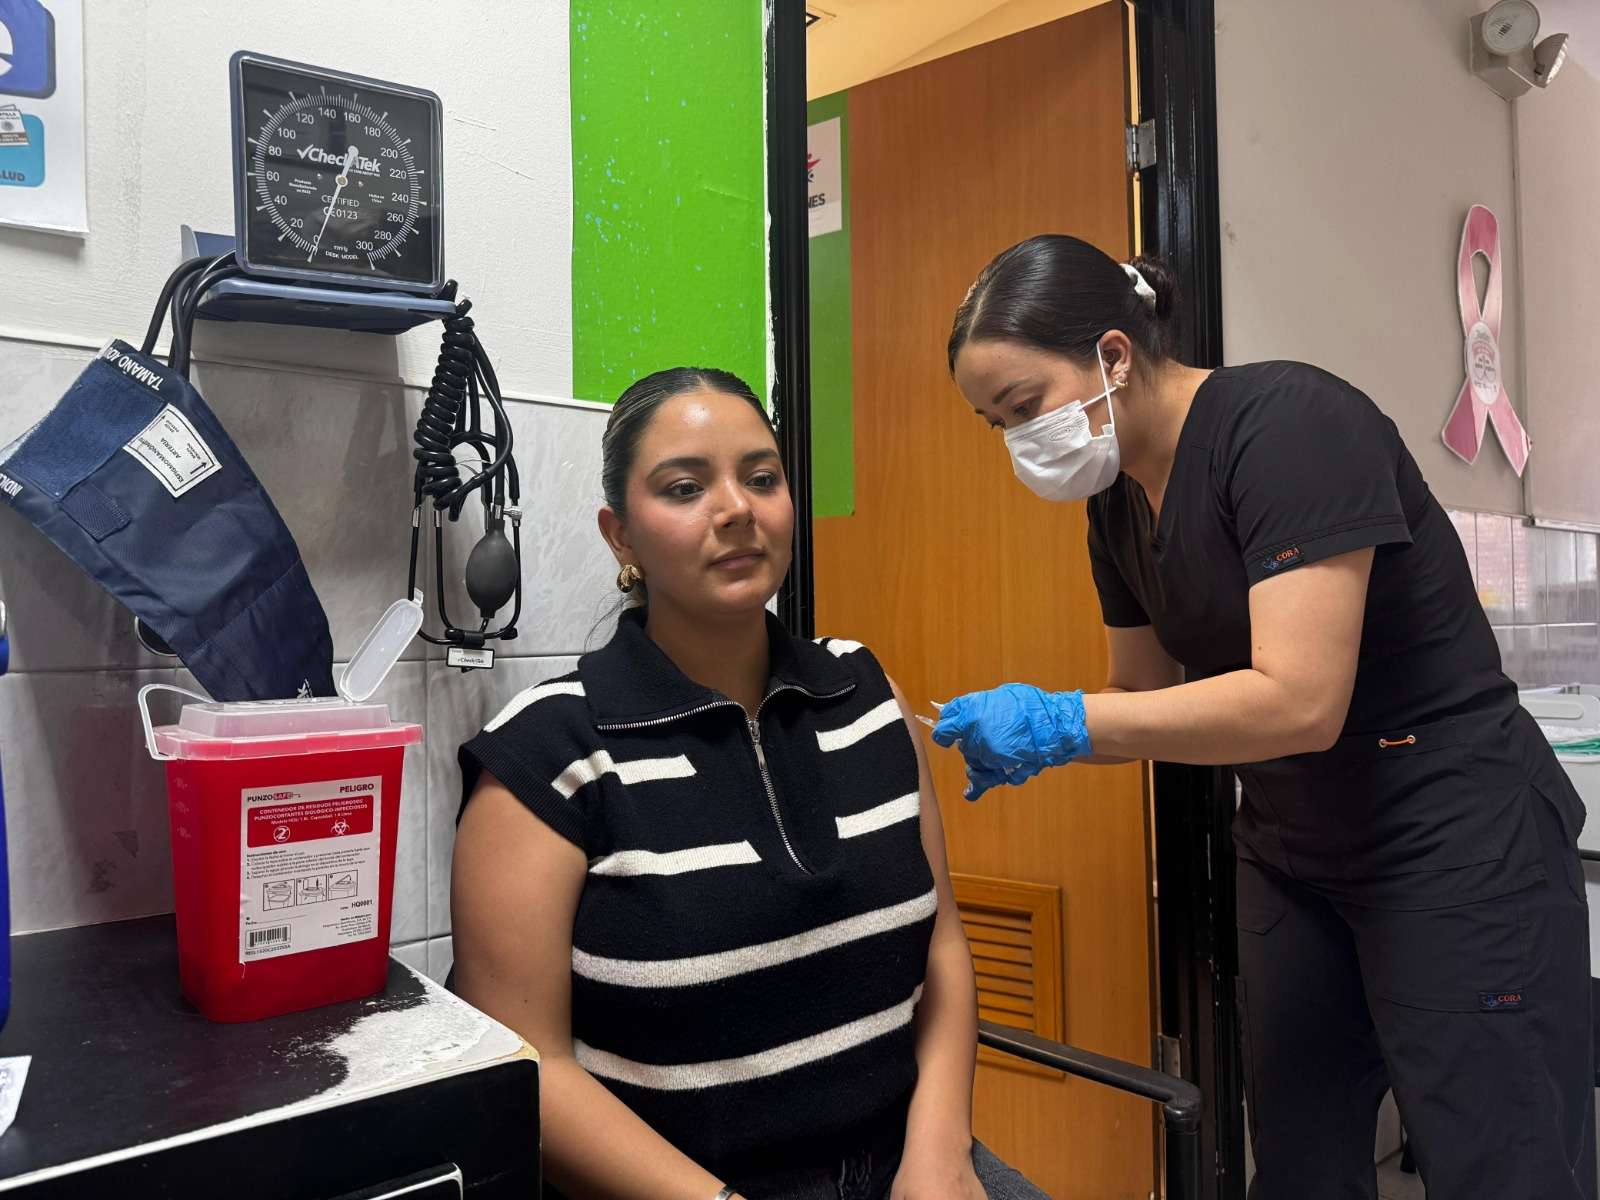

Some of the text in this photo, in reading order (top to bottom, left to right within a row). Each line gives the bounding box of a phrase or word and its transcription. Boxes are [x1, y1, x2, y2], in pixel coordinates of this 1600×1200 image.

[296, 112, 314, 125] 120
[318, 107, 337, 120] 140
[344, 112, 361, 124] 160
[277, 128, 296, 140] 100
[364, 126, 381, 138] 180
[268, 145, 282, 157] 80
[380, 148, 398, 160] 200
[0, 170, 25, 182] LUD
[266, 170, 280, 182] 60
[389, 168, 407, 180] 220
[274, 196, 288, 206] 40
[392, 193, 409, 204] 240
[290, 218, 304, 229] 20
[386, 212, 404, 223] 260
[313, 234, 320, 245] 0
[374, 230, 392, 241] 280
[356, 240, 374, 251] 300
[118, 356, 164, 391] TAMAÑO
[340, 783, 374, 794] PELIGRO
